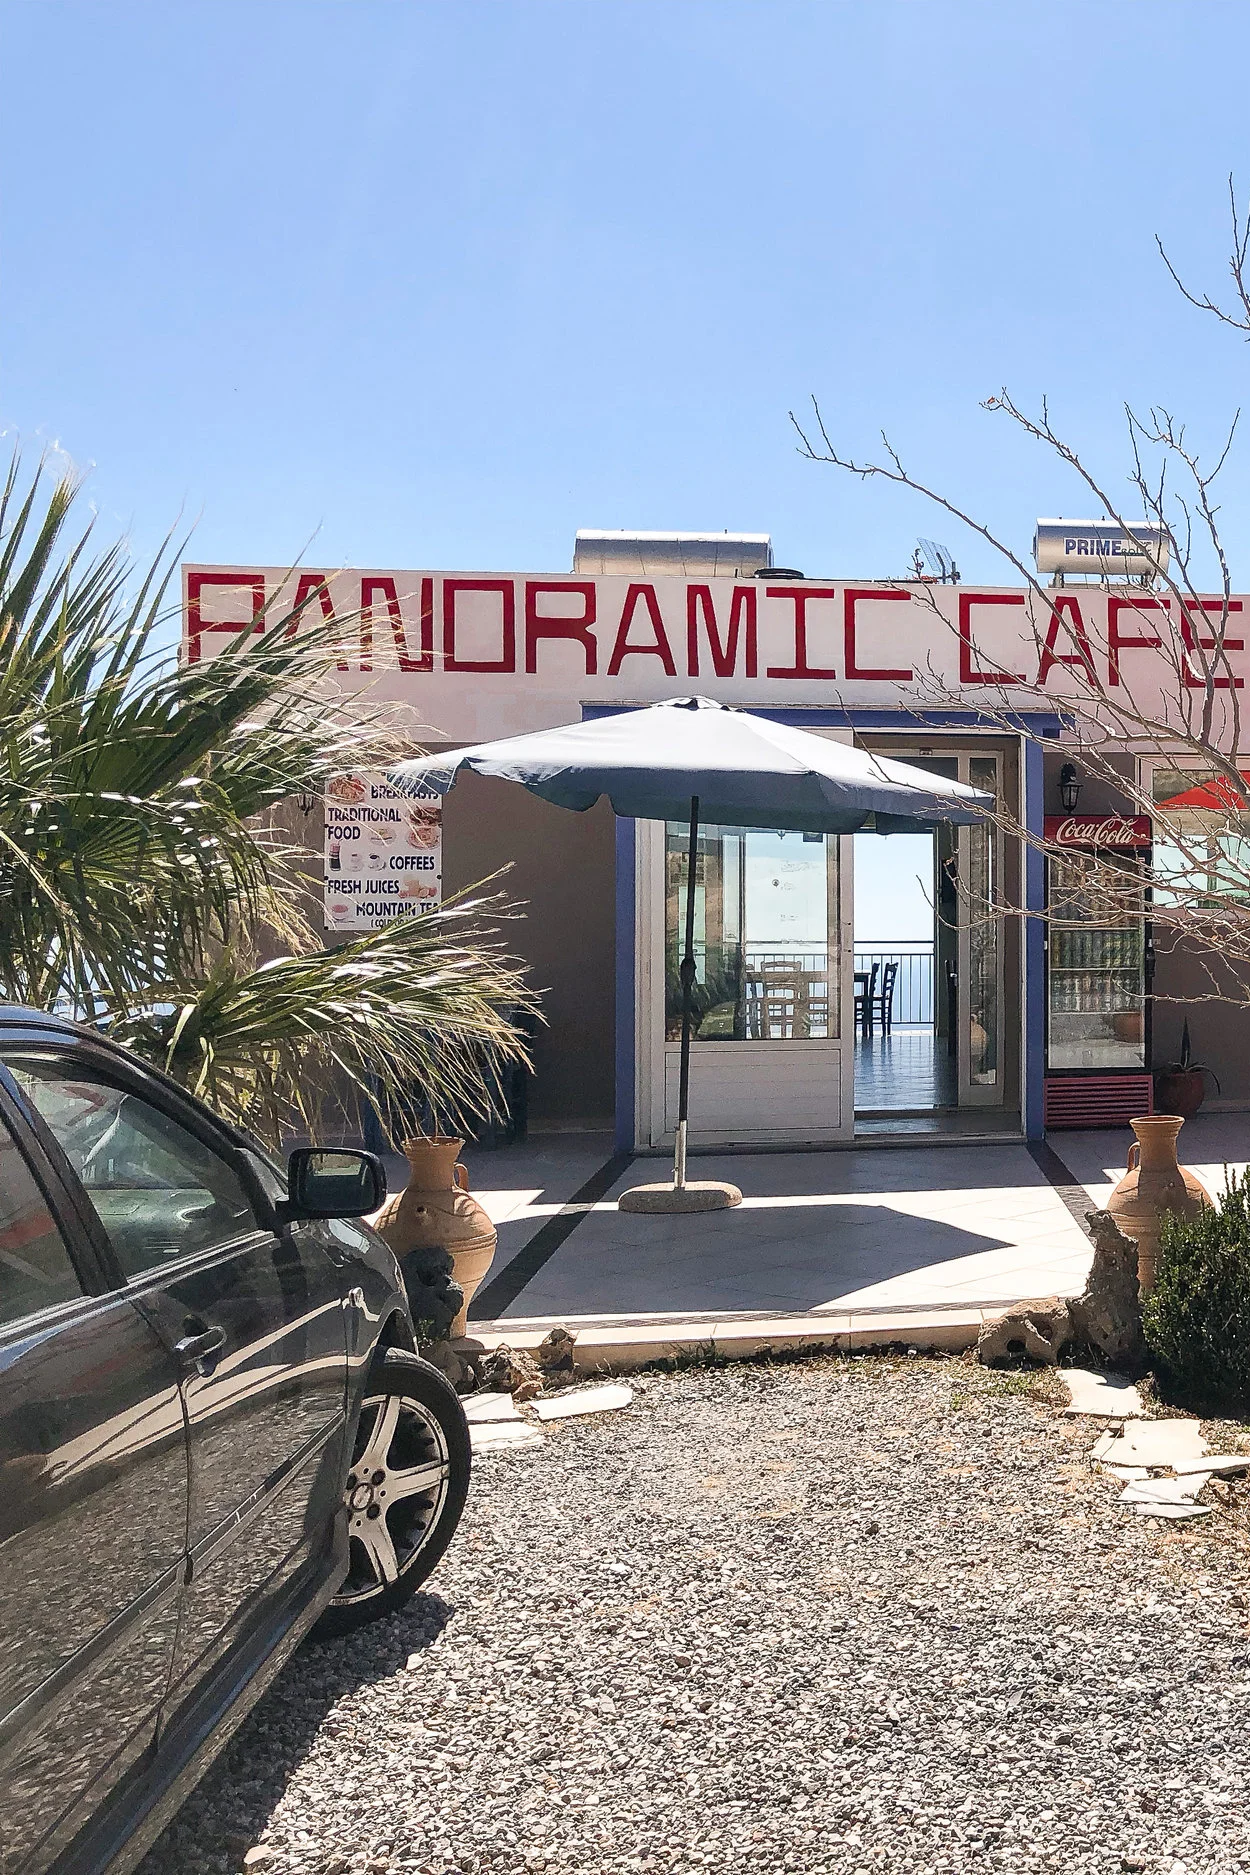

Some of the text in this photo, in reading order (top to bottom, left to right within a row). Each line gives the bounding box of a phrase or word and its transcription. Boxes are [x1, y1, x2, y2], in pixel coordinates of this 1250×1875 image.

[1065, 539, 1121, 556] PRIME
[188, 573, 912, 680] PANORAMIC
[959, 593, 1244, 688] CAFE
[328, 807, 401, 822] TRADITIONAL
[328, 826, 361, 840] FOOD
[389, 856, 435, 870] COFFEES
[328, 880, 400, 894] FRESH JUICES
[356, 902, 418, 917] MOUNTAIN
